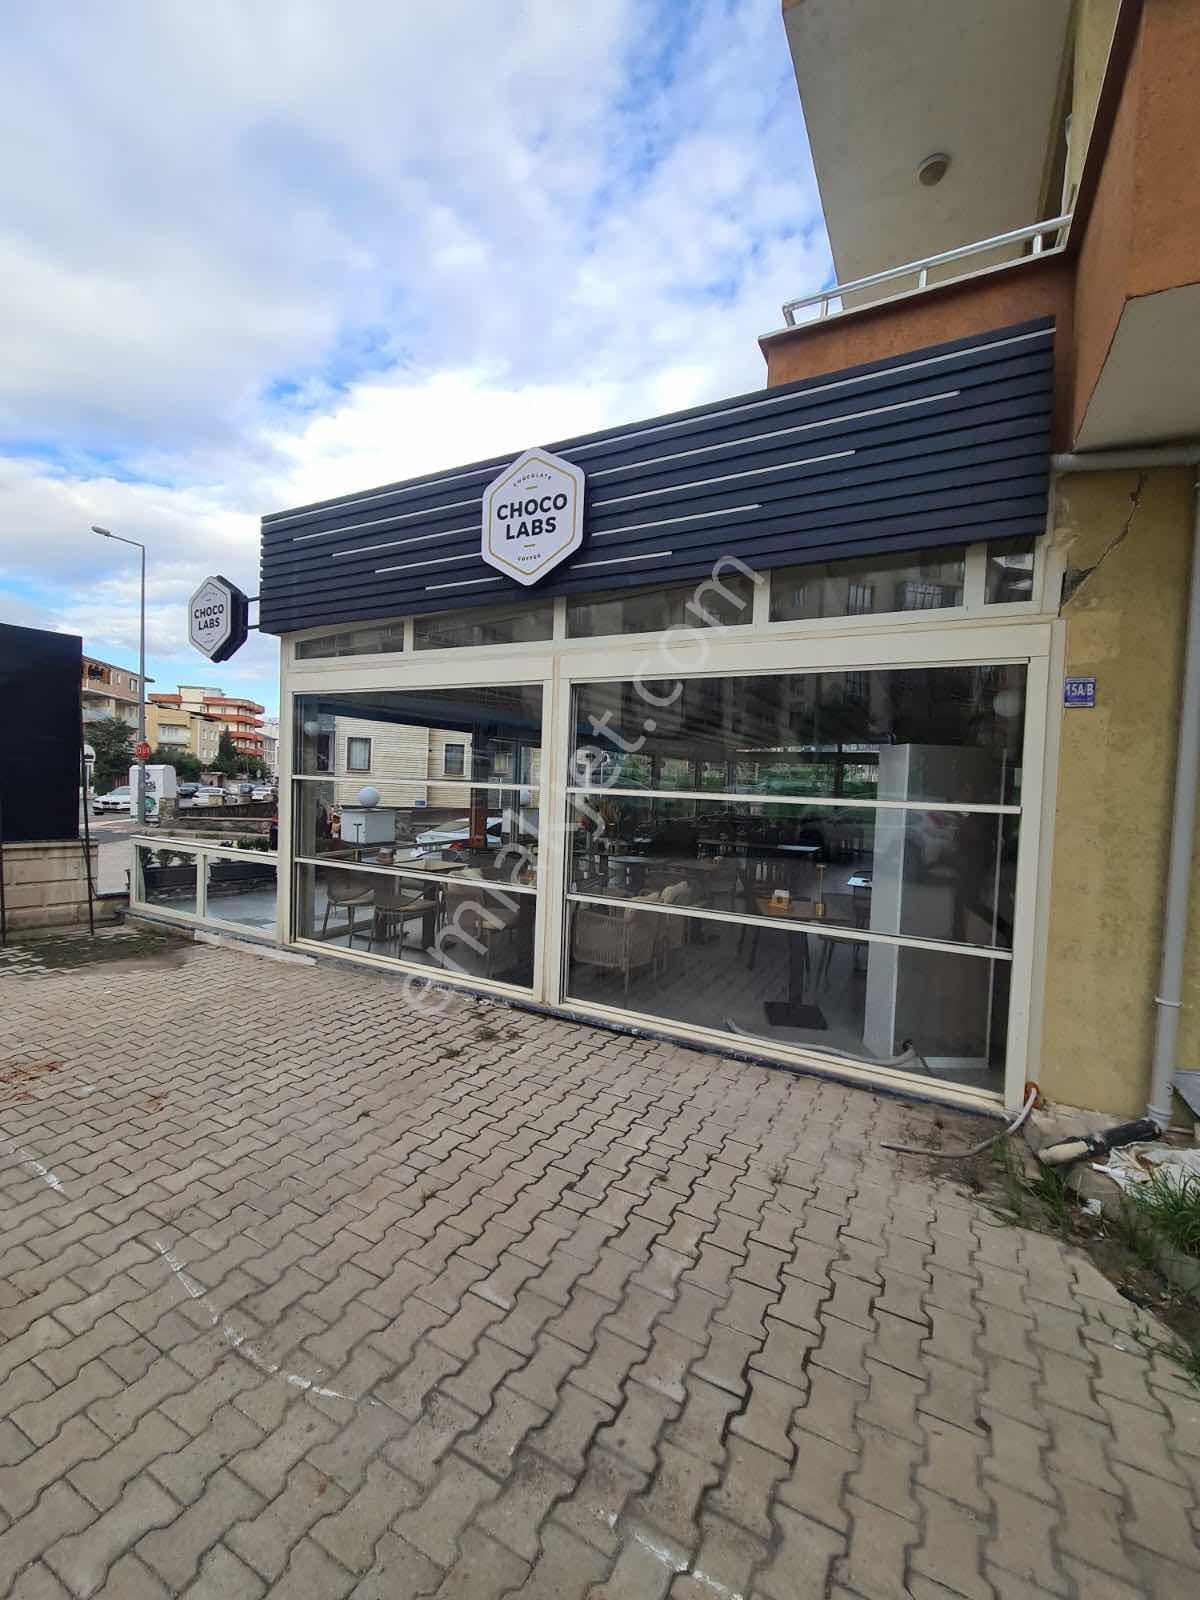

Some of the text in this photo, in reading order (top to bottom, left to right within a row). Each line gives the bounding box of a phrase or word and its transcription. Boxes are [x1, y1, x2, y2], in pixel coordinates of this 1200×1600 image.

[497, 493, 568, 520] CHOCO
[506, 517, 557, 540] LABS
[194, 604, 224, 619] CHOCO
[198, 617, 221, 631] LABS
